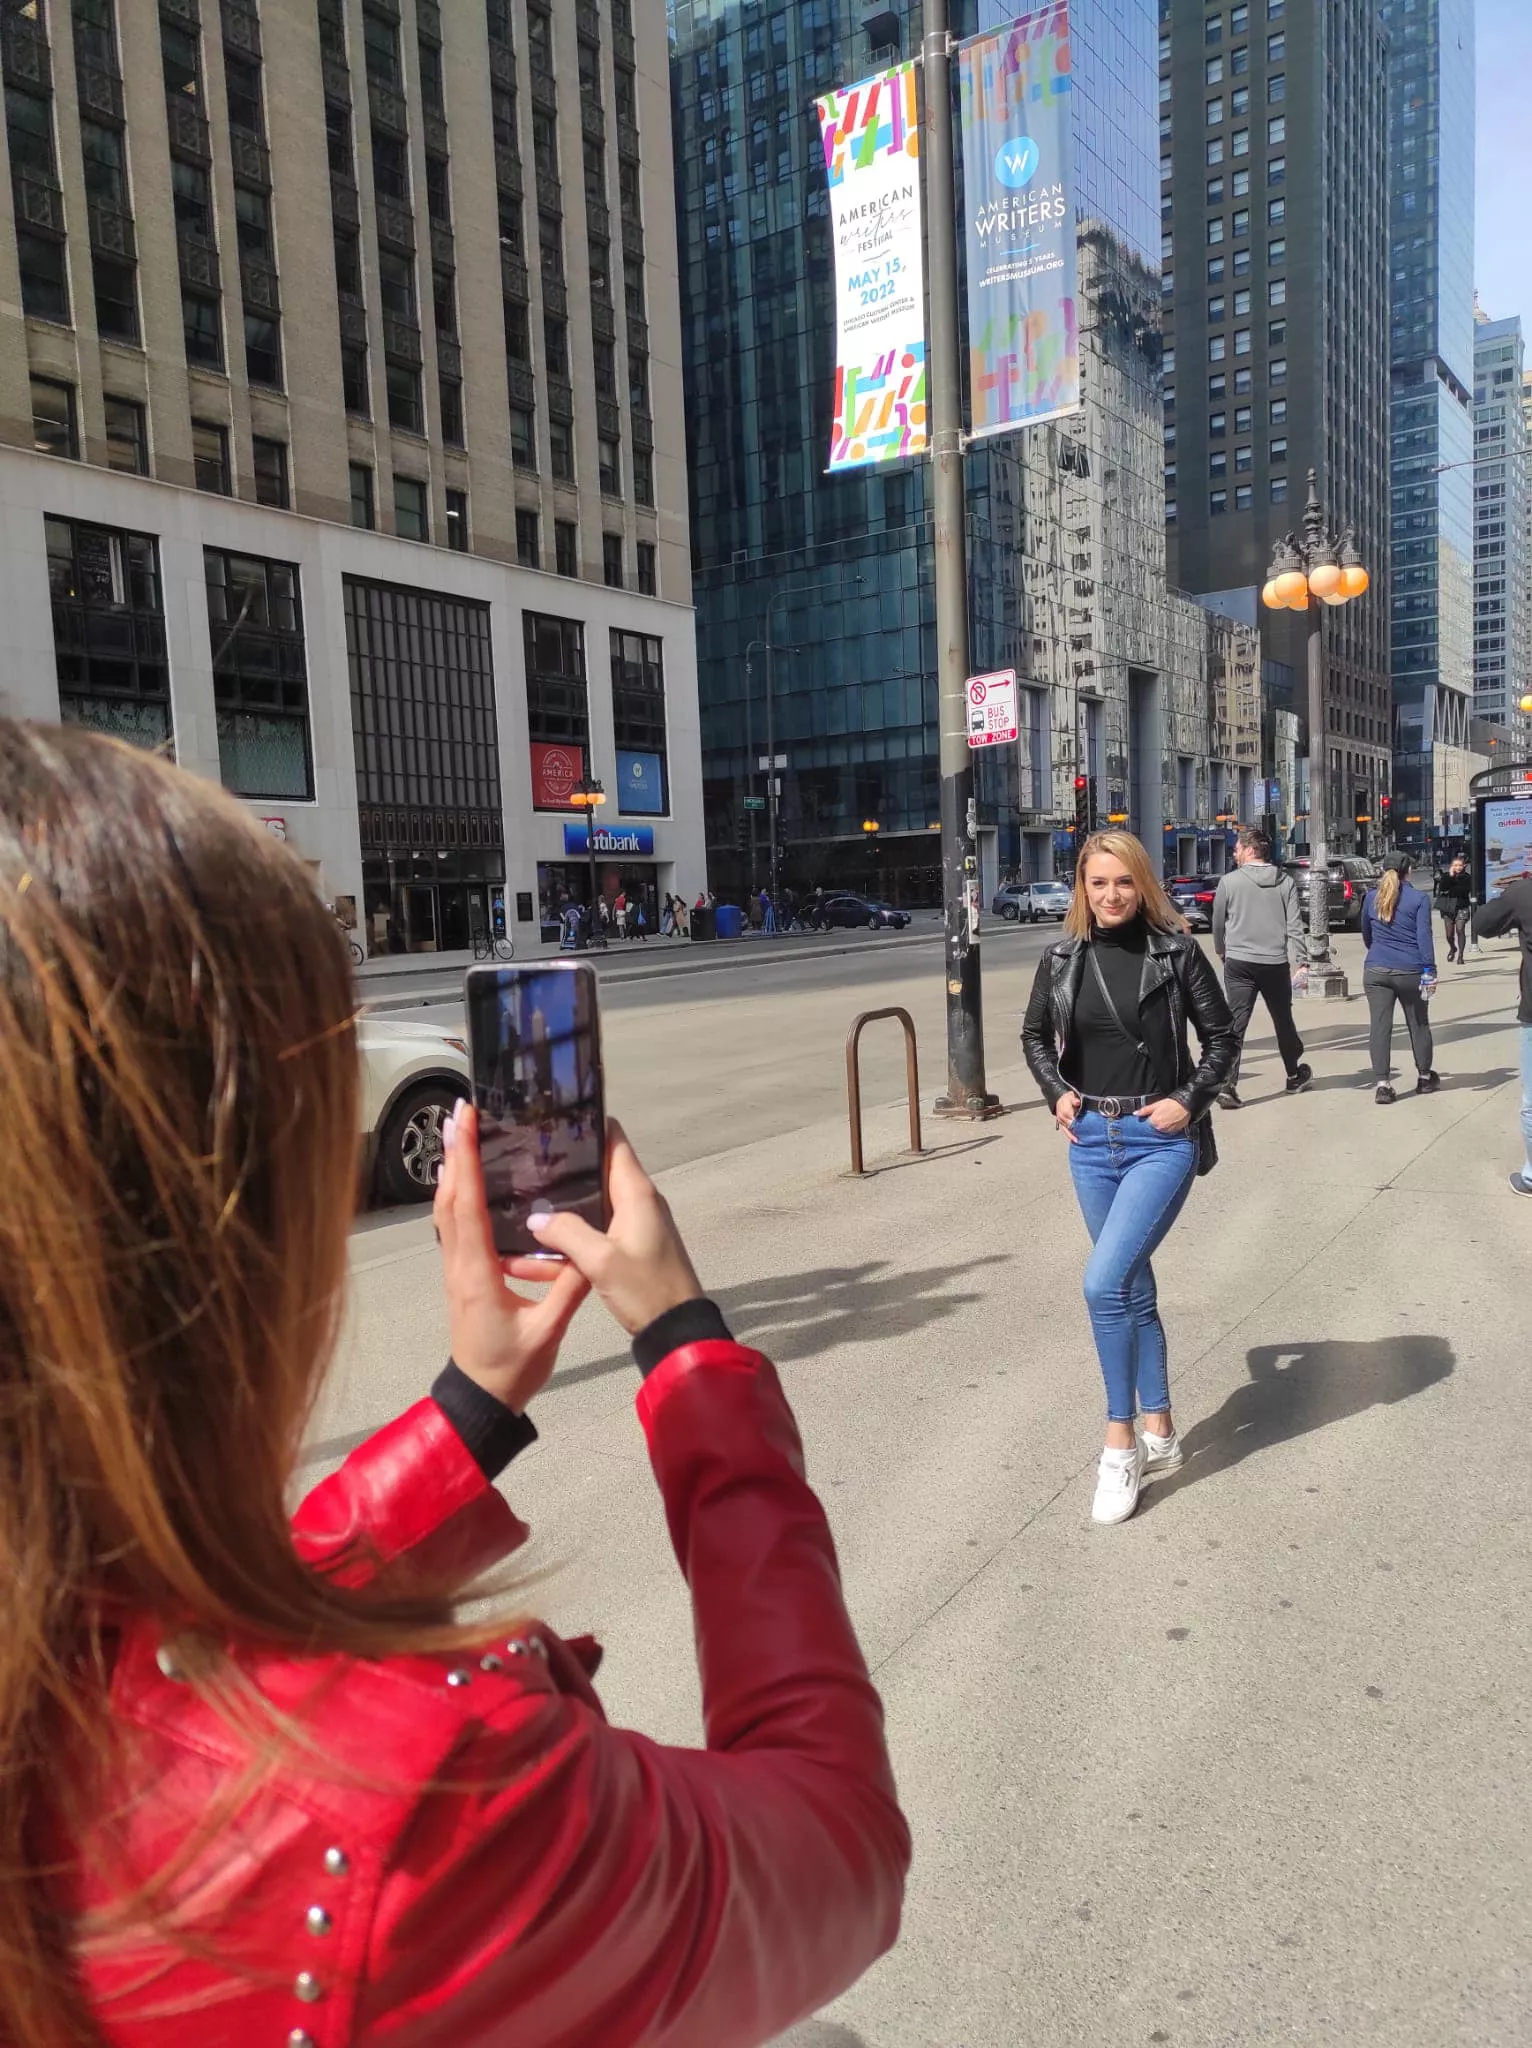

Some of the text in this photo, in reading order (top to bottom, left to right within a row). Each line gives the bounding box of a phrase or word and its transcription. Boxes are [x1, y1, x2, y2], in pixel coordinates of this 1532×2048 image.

[839, 185, 913, 227] AMERICAN
[978, 182, 1062, 216] AMERICAN
[975, 197, 1066, 238] WRITERS
[858, 229, 893, 254] FESTIVAL
[980, 221, 1062, 249] MUSEUM
[848, 256, 906, 292] MAY 15,
[979, 259, 1065, 288] WRITERSMUSEUM.ORG
[986, 259, 1028, 275] CELEBRATING
[1034, 251, 1055, 264] YEARS
[860, 279, 896, 307] 2022
[988, 705, 1005, 718] BUS
[988, 717, 1010, 730] STOP
[972, 730, 1013, 745] TOW ZONE
[542, 769, 574, 777] AMERICA
